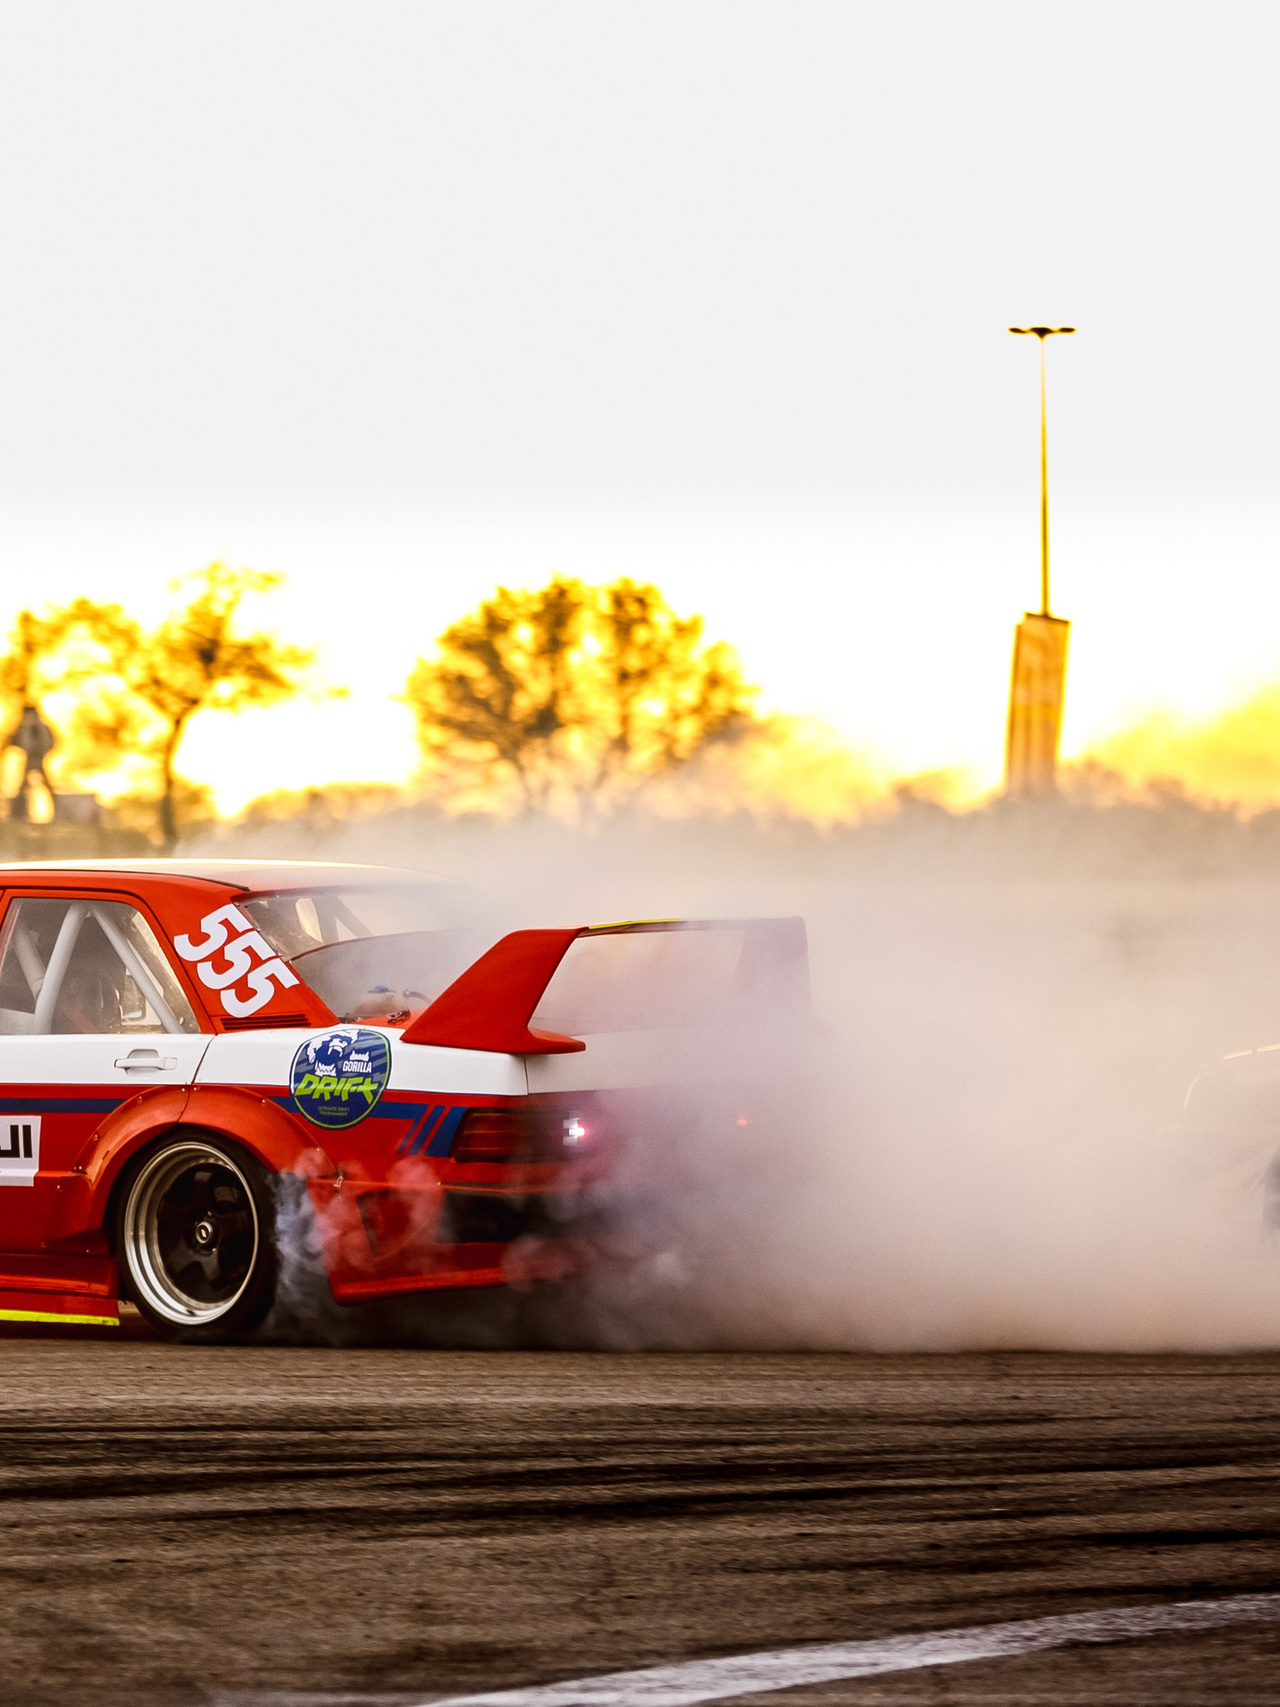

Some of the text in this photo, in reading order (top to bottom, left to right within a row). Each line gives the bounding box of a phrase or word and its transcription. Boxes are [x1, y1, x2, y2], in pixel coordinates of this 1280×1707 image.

[173, 904, 300, 1018] 555
[342, 1061, 372, 1073] GORILLA
[295, 1073, 378, 1105] DRIFT
